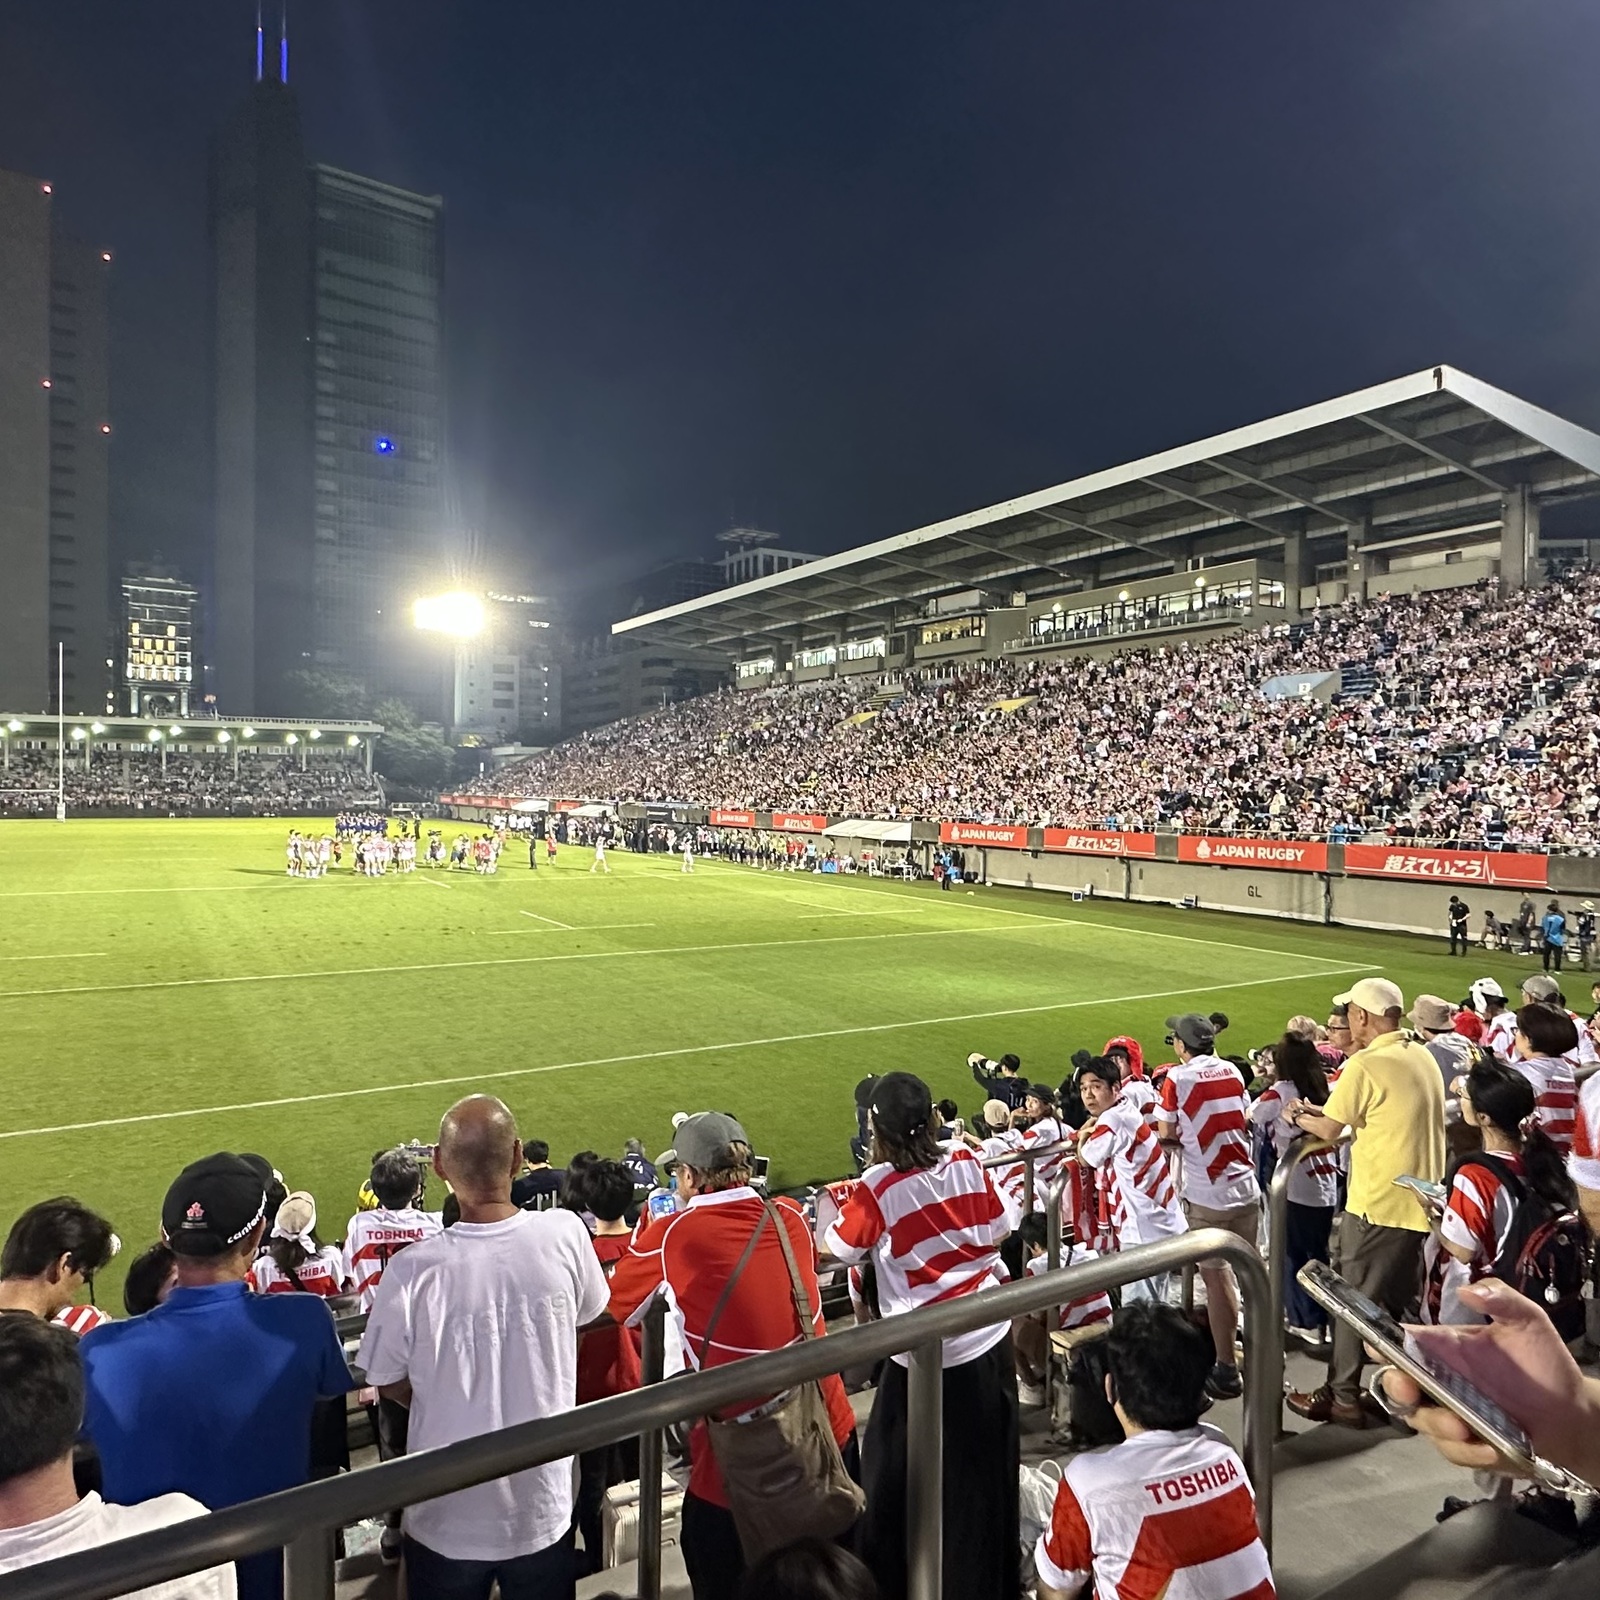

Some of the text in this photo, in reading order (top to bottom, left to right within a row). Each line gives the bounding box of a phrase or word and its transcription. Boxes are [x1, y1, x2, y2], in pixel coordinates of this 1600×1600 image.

[960, 829, 1015, 842] JAPAN RUGBY
[1065, 835, 1121, 850] 超えていこう
[1212, 844, 1305, 861] JAPAN RUGBY
[1382, 854, 1482, 878] 超えていこう
[1247, 885, 1262, 898] GL
[1197, 1068, 1234, 1079] TOSHIBA
[366, 1228, 424, 1240] TOSHIBA
[277, 1265, 327, 1279] THIBA
[1144, 1459, 1239, 1505] TOSHIBA
